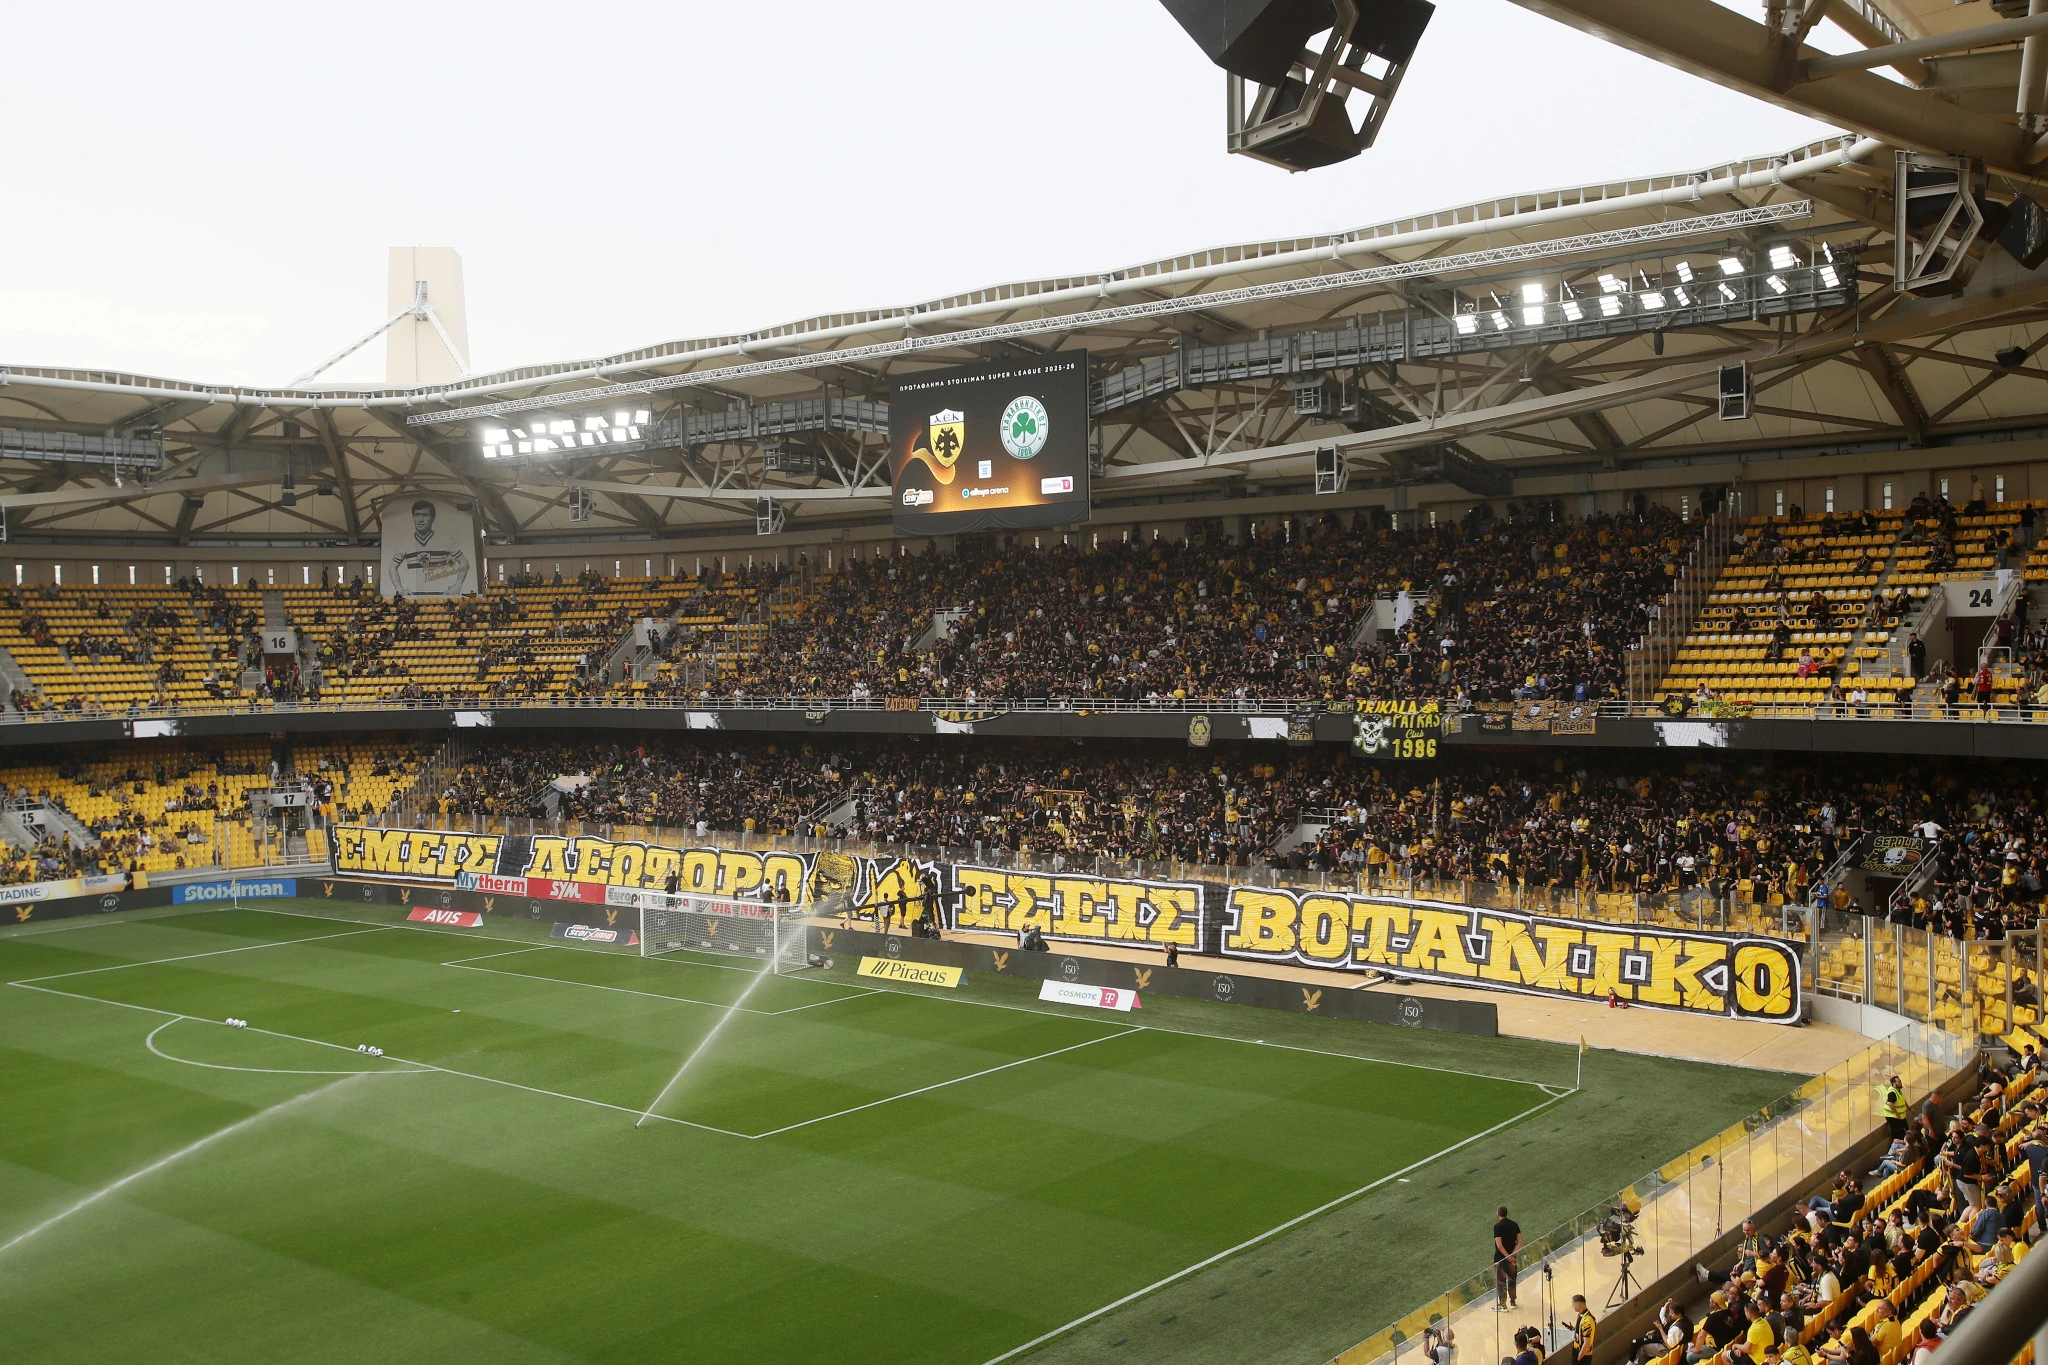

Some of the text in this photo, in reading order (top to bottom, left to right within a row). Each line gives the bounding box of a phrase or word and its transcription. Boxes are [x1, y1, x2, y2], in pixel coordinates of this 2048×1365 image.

[947, 375, 985, 386] STOIXIMAN
[988, 371, 1011, 380] SUPER
[1013, 367, 1042, 377] LEAGUE
[1044, 362, 1075, 373] 2025-26
[1969, 588, 1993, 607] 24
[271, 637, 286, 648] 16
[1405, 728, 1424, 739] Club
[1392, 739, 1437, 758] 1986
[283, 794, 295, 805] 17
[1874, 835, 1923, 851] SEPOLIA
[456, 871, 524, 892] Mytherm
[184, 883, 284, 901] Stoiximan
[550, 881, 582, 899] SYM
[336, 828, 498, 876] ΕΜΕΙΣ
[958, 869, 1197, 945] ΕΣΕΙΣ
[1228, 889, 1792, 1013] ΒΟΤΑΝΙΚΟ
[423, 909, 463, 924] AVIS
[889, 962, 947, 984] Piraeus
[1064, 964, 1077, 974] 150
[1058, 989, 1097, 1001] COSMOTE
[1217, 982, 1230, 994] 150
[1404, 1006, 1419, 1018] 150
